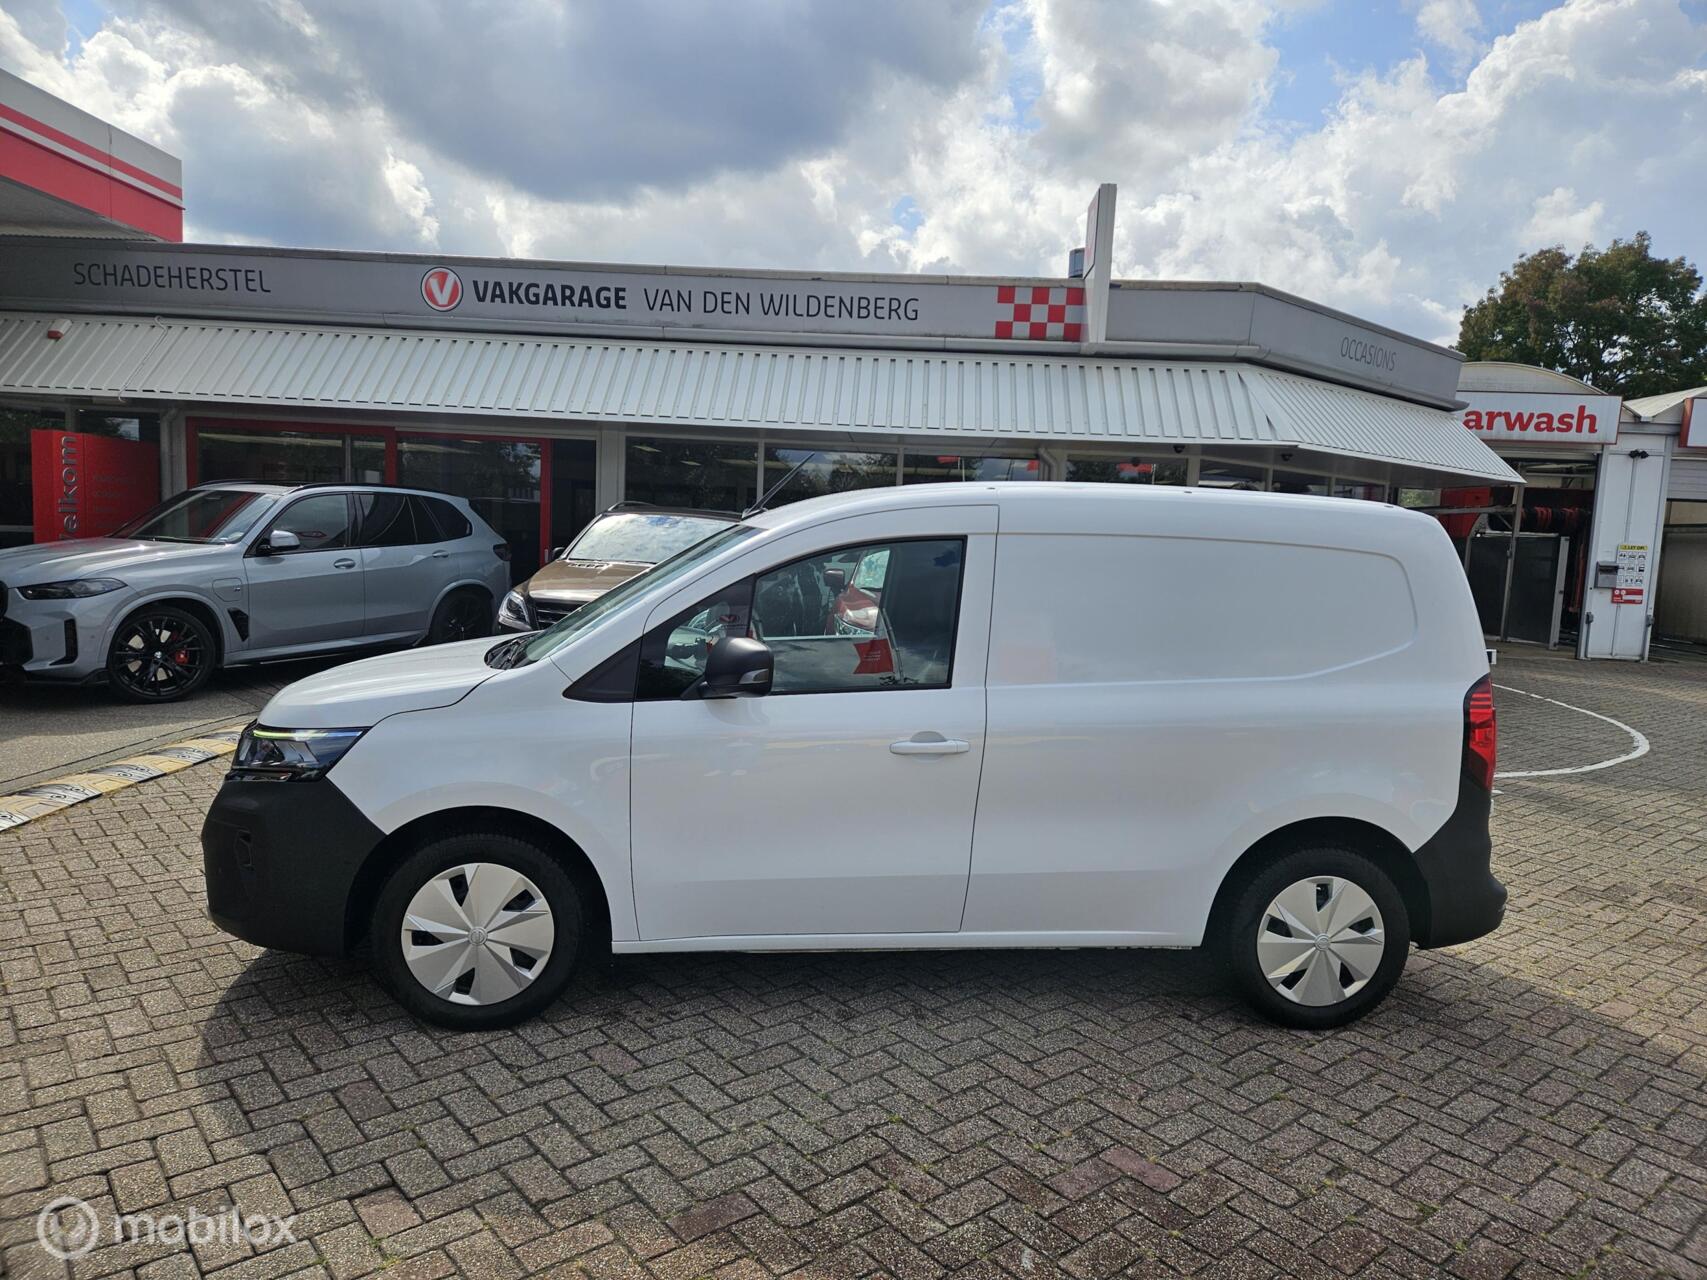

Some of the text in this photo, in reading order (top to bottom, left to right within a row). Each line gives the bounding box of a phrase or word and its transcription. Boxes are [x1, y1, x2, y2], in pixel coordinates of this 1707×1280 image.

[73, 262, 271, 293] SCHADEHERSTEL
[472, 279, 919, 321] VAKGARAGE VAN DEN WILDENBERG
[1340, 336, 1397, 372] OCCASIONS
[1462, 404, 1598, 434] arwash
